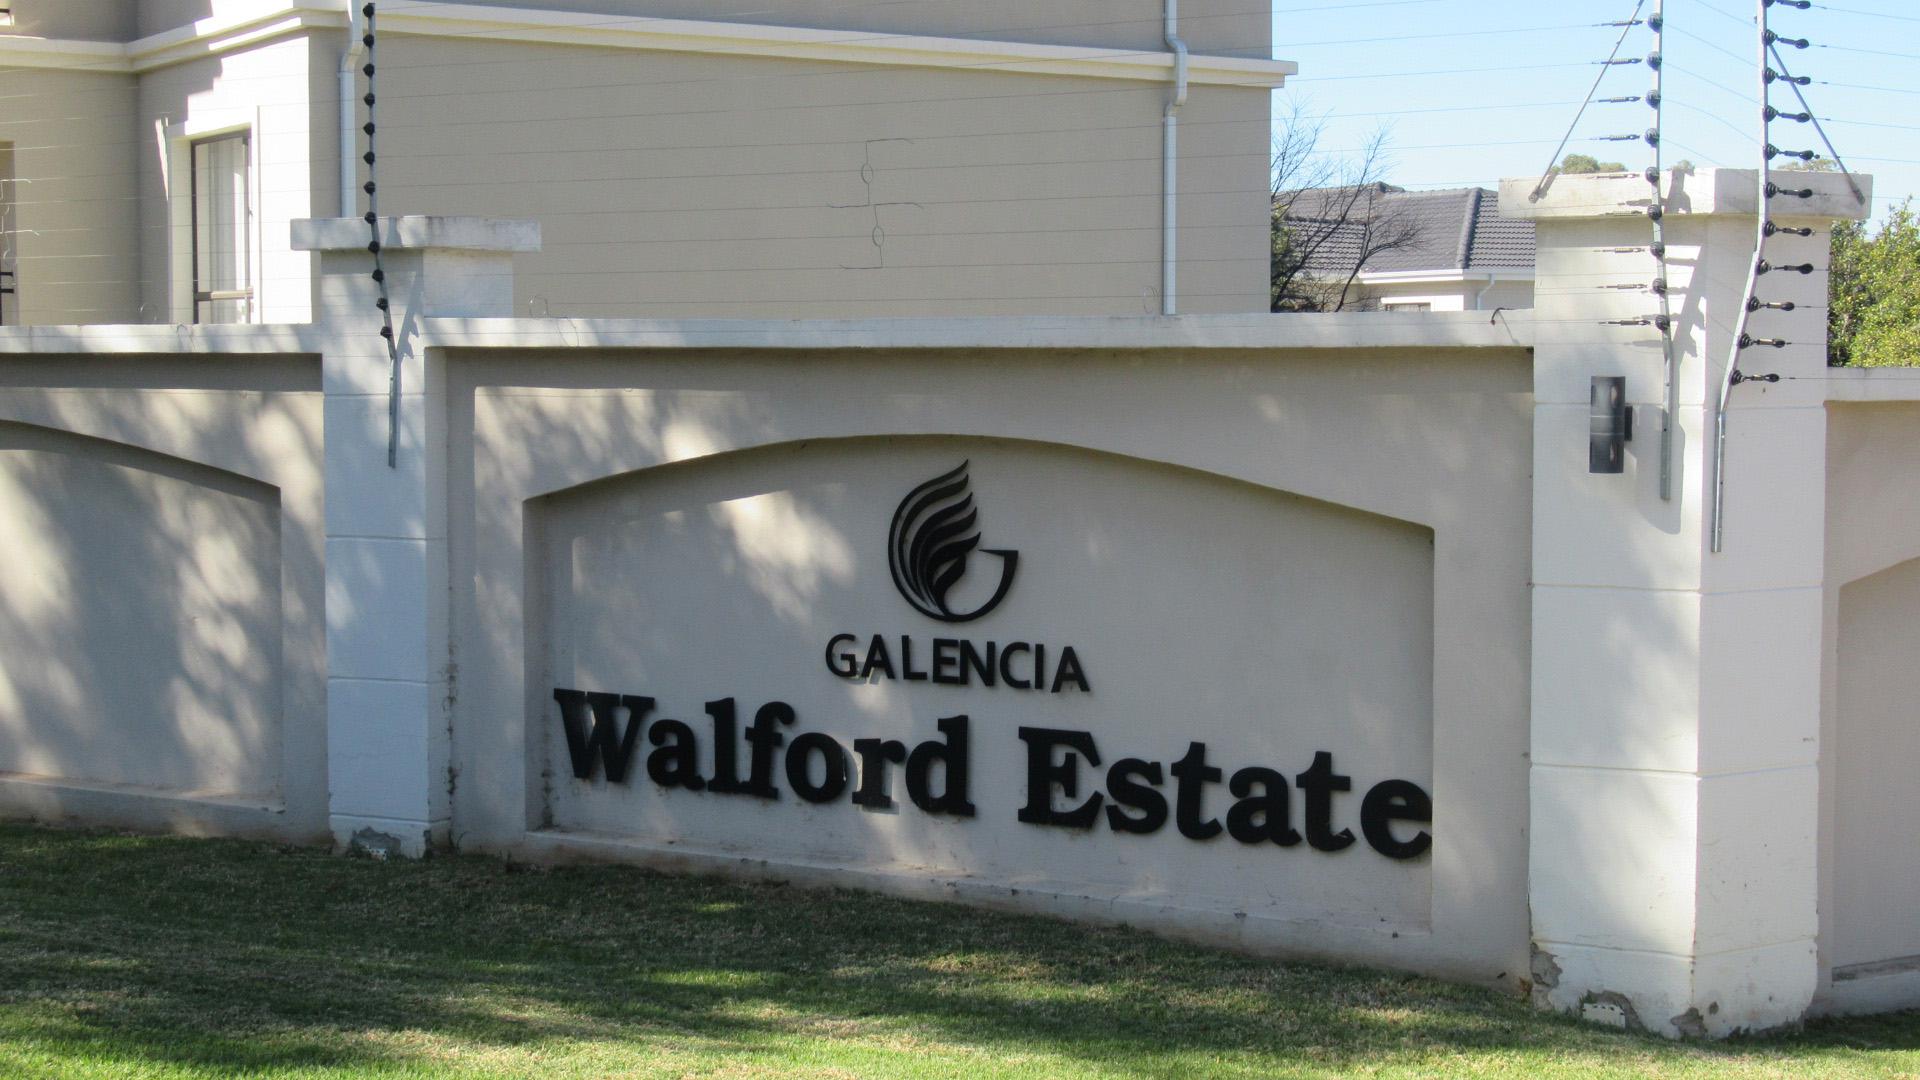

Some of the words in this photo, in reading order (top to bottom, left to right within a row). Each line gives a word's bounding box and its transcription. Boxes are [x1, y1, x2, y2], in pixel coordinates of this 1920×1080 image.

[826, 633, 1091, 694] GALENCIA
[554, 689, 976, 817] Walford
[1018, 726, 1432, 860] Estate
